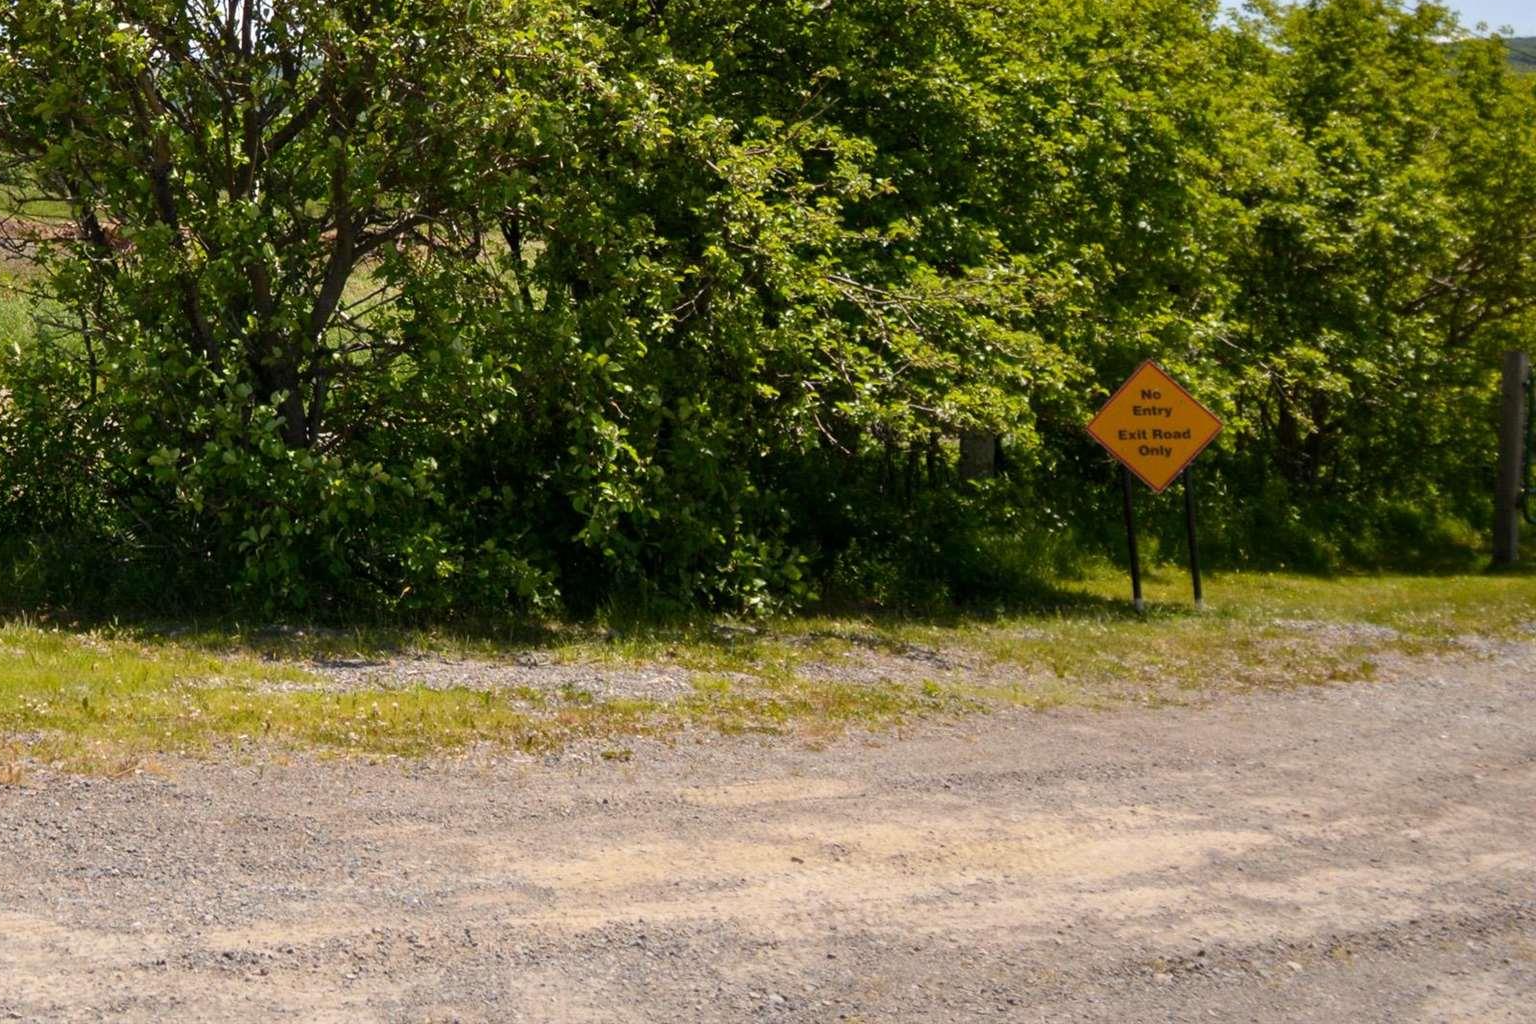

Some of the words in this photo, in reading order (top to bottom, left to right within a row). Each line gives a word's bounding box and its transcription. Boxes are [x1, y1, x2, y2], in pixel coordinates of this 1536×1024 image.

[1140, 389, 1162, 400] No
[1132, 405, 1173, 418] Entry
[1118, 429, 1148, 441] Exit
[1152, 429, 1191, 440] Road
[1138, 445, 1173, 458] Only
